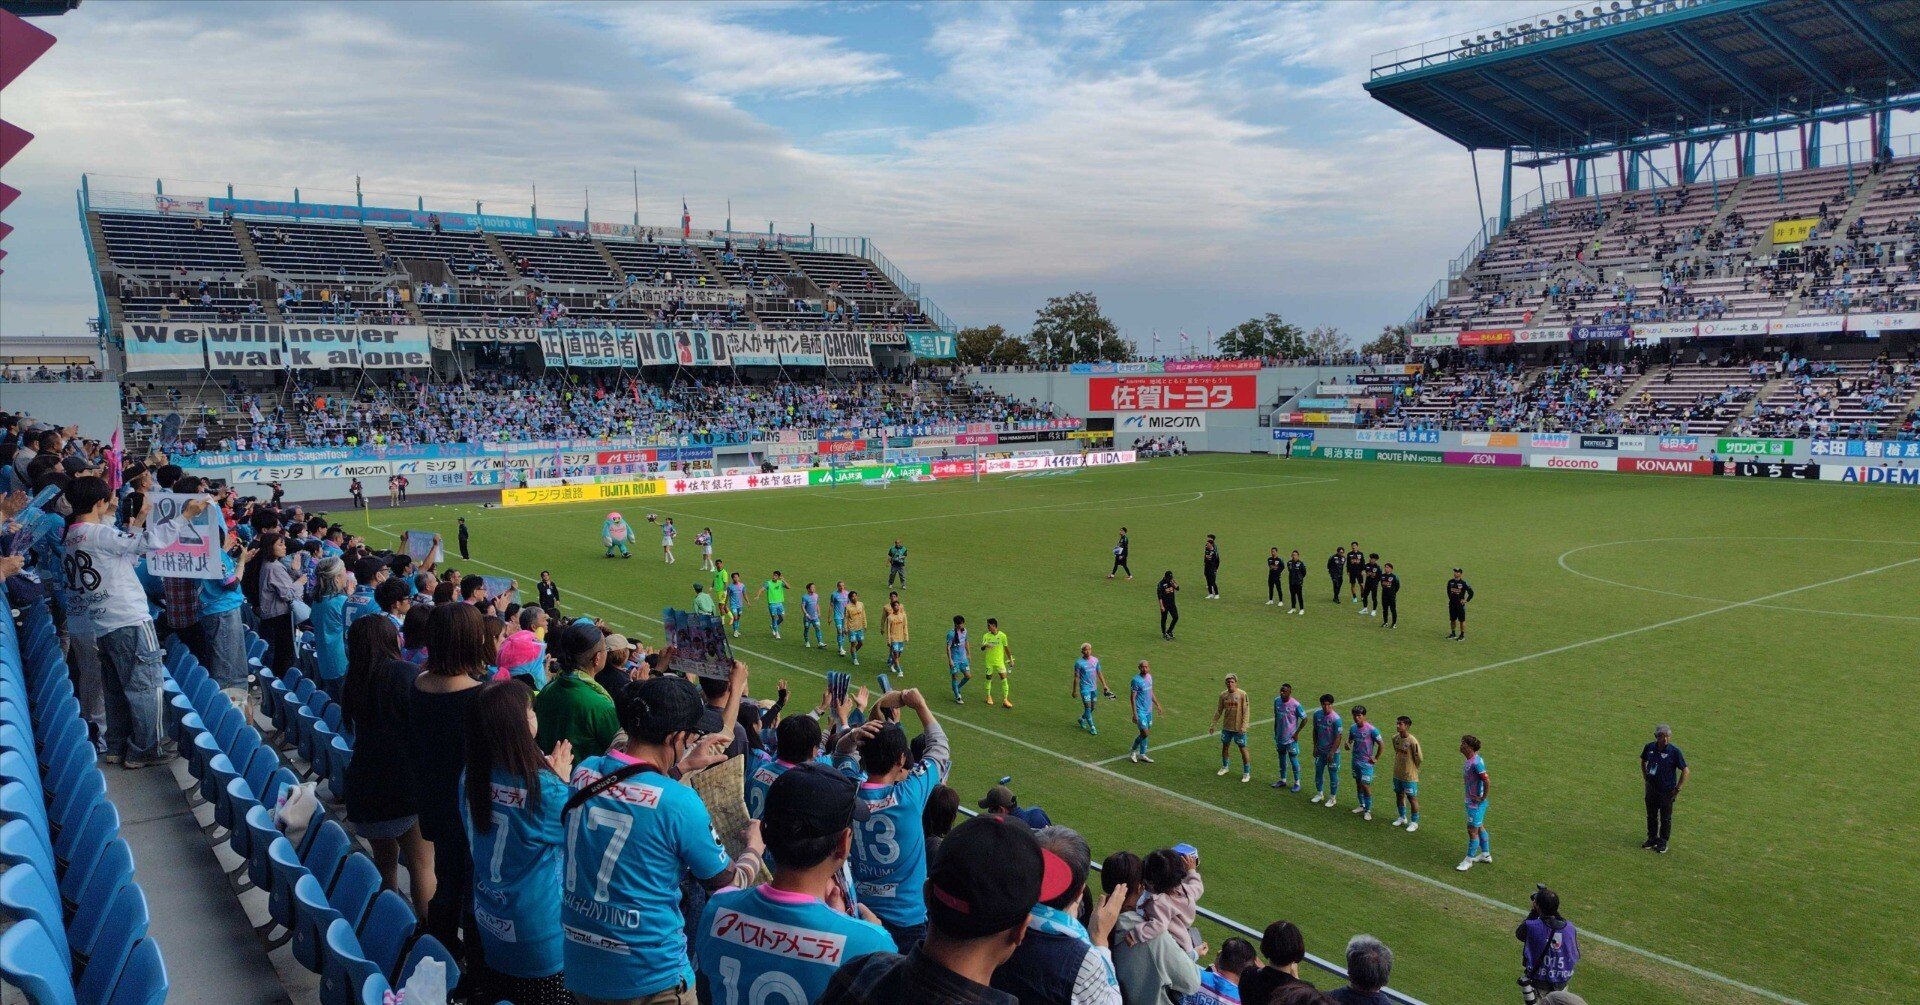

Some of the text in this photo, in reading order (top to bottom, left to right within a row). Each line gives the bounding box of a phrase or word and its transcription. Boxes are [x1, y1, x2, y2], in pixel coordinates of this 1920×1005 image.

[467, 215, 481, 226] est
[484, 216, 510, 228] notre
[513, 218, 527, 230] vie
[1813, 320, 1840, 328] PLASTIC
[131, 325, 398, 344] We will never
[458, 327, 537, 340] KYUSYU
[869, 333, 905, 344] PRISCO
[542, 330, 635, 360] 正直田舎者
[727, 333, 822, 355] 恋人がサガン鳥栖
[825, 333, 869, 358] CAFONE
[935, 336, 951, 355] 17
[213, 347, 431, 366] walk alone.
[829, 357, 870, 366] FOOTBALL
[1112, 386, 1234, 409] 佐賀トヨタ
[1149, 416, 1201, 428] MIZOTA
[751, 431, 780, 443] ALWAYS
[1324, 447, 1363, 460] 明治安田
[1726, 441, 1767, 454] サロンパス
[1811, 440, 1883, 457] 本田風智
[200, 455, 230, 466] PRIDE
[265, 450, 298, 462] Vamos
[1376, 452, 1402, 461] ROUTE
[1547, 456, 1599, 469] docomo
[346, 466, 387, 476] MIZOTA
[1636, 460, 1693, 472] KONAMI
[1743, 464, 1809, 479] いちご
[688, 478, 734, 492] 佐賀銀行
[760, 474, 802, 488] 佐賀銀行
[527, 487, 584, 503] フジタ道路
[600, 482, 656, 498] FUJITA ROAD
[853, 814, 901, 866] 13
[562, 806, 634, 903] 17
[735, 920, 840, 963] ベストアメニティ
[1544, 955, 1564, 969] 015
